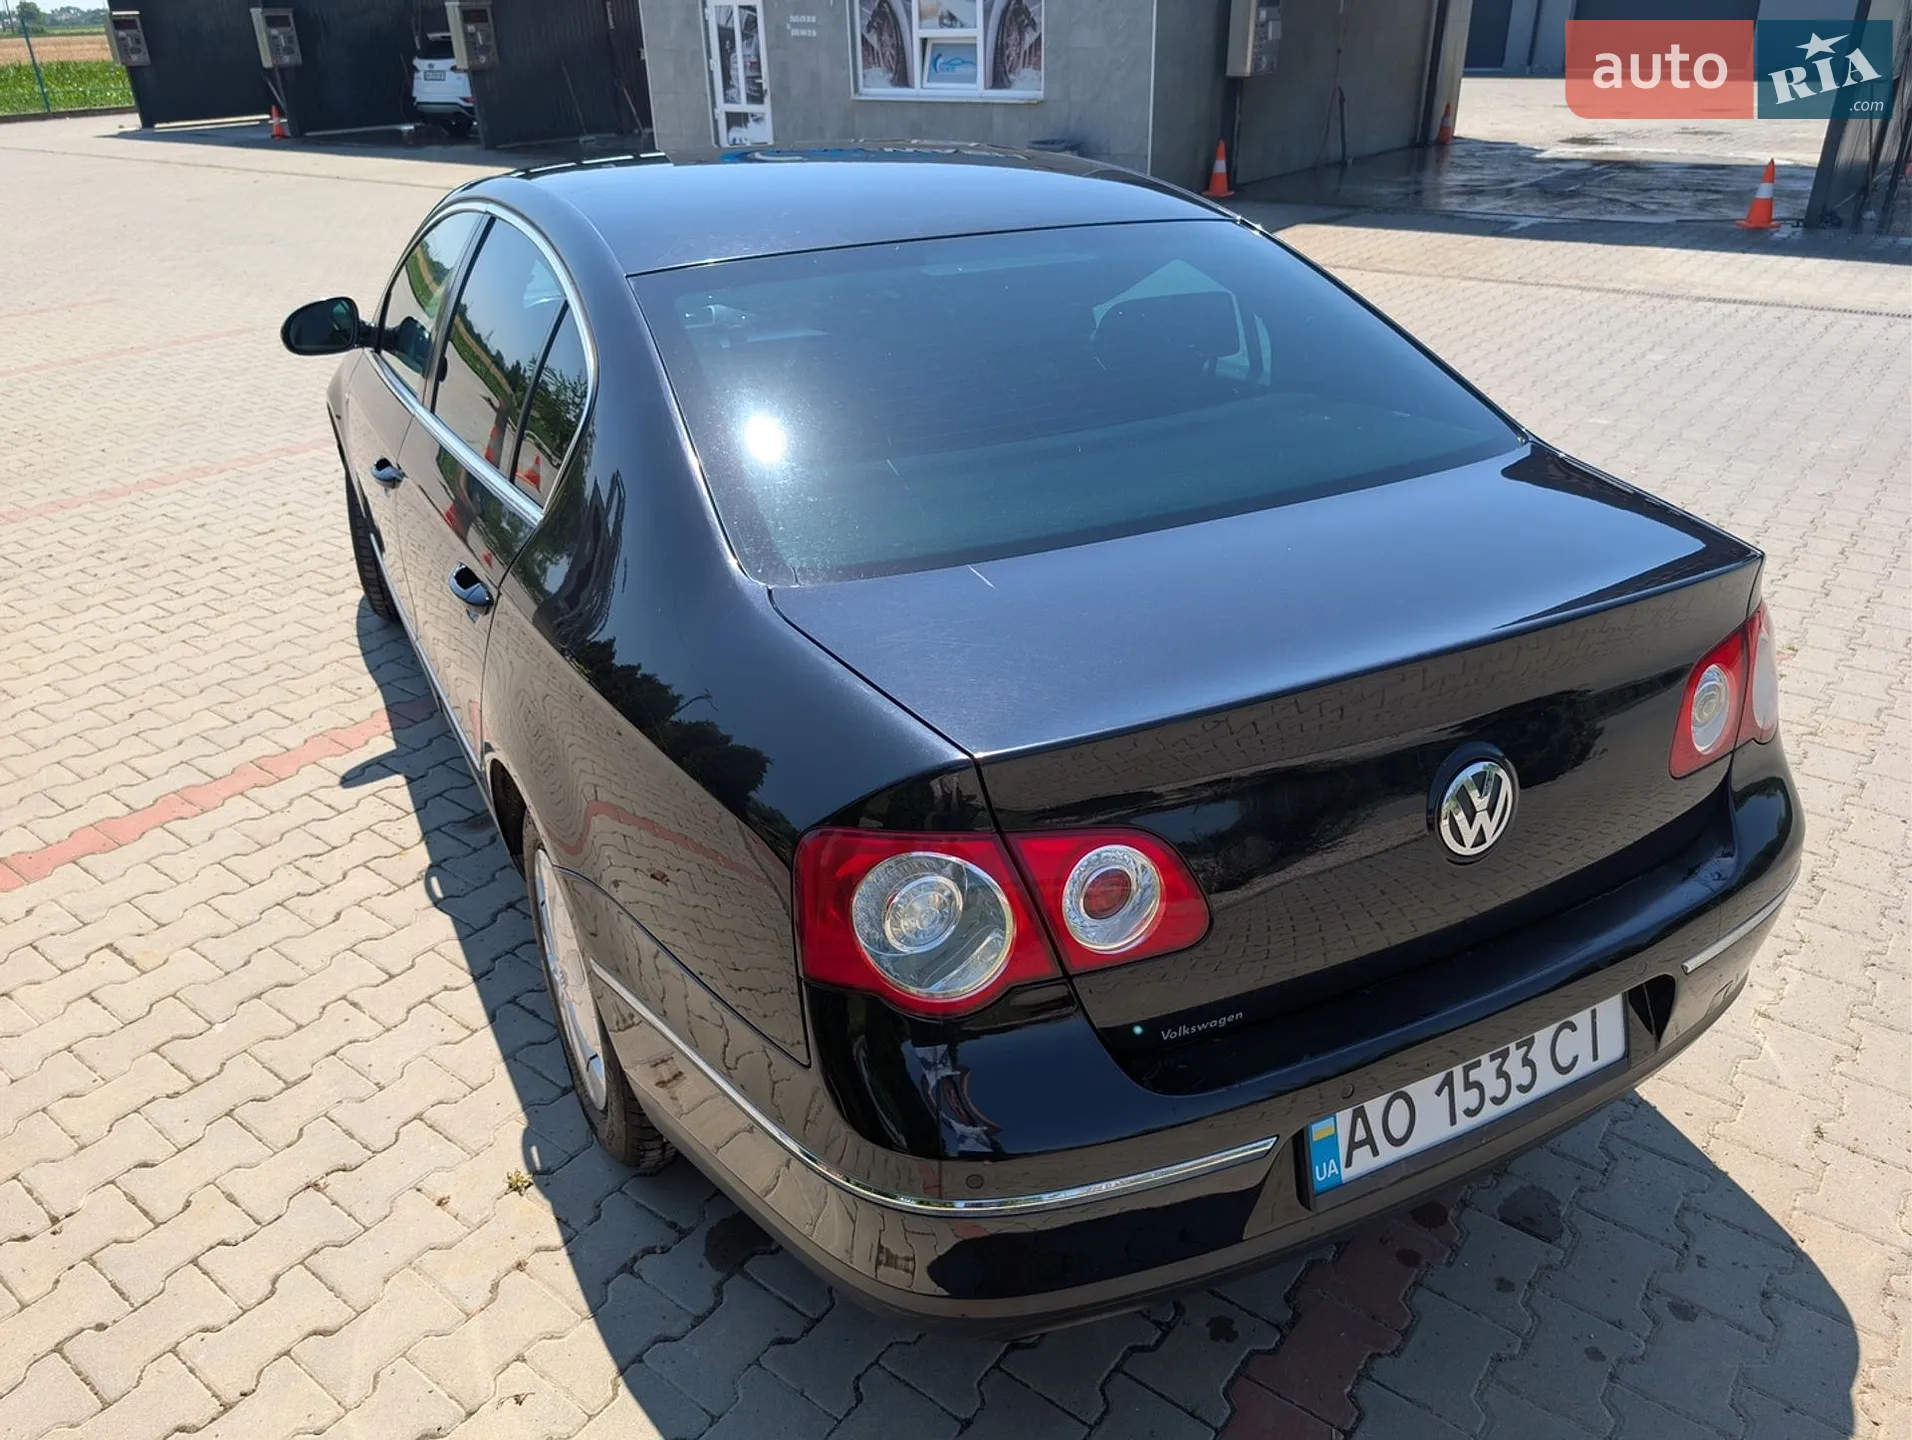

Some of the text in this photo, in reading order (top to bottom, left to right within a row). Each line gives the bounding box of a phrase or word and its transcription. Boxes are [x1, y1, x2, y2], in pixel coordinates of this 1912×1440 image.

[1441, 761, 1513, 855] VW
[1161, 1011, 1243, 1040] Volkswagen
[1344, 1007, 1599, 1169] AO 1533 CI
[1315, 1158, 1339, 1181] UA
